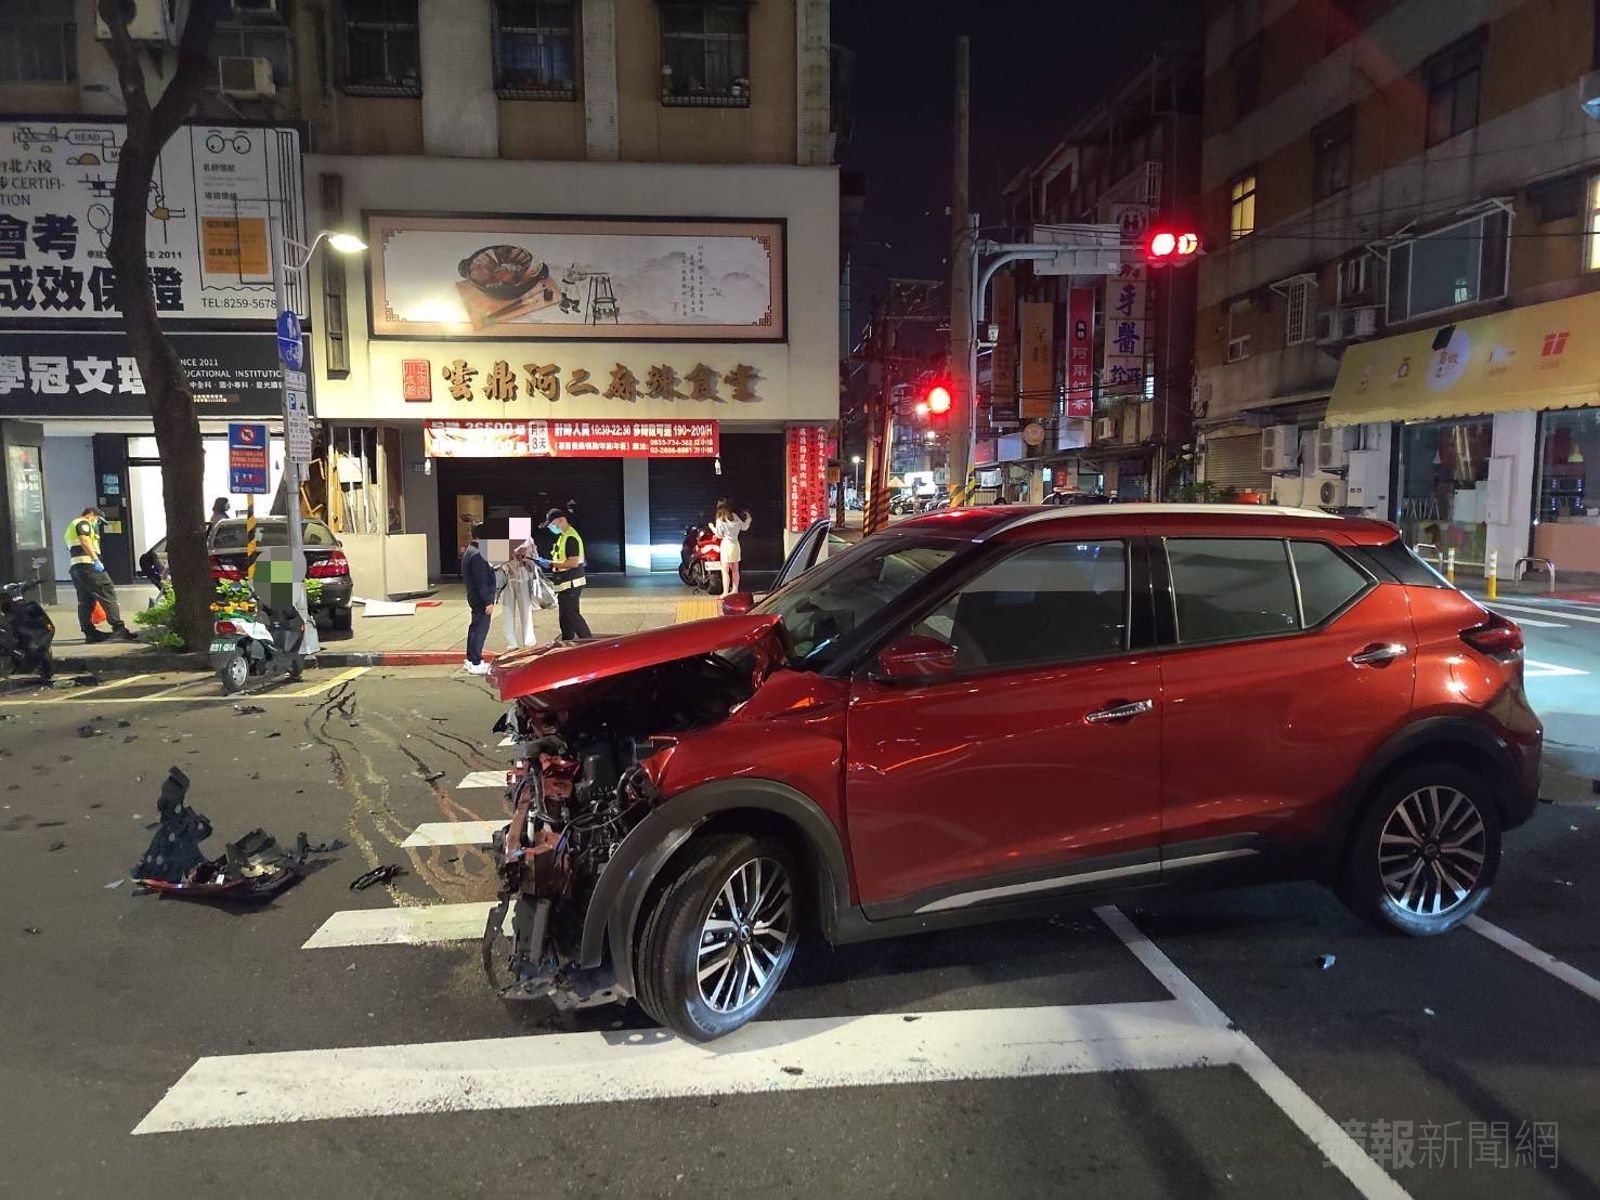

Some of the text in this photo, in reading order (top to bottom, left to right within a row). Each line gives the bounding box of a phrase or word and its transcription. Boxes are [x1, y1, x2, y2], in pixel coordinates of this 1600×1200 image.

[184, 370, 231, 378] UCATIONAL
[441, 359, 763, 402] 雲鼎阿二麻辣食堂
